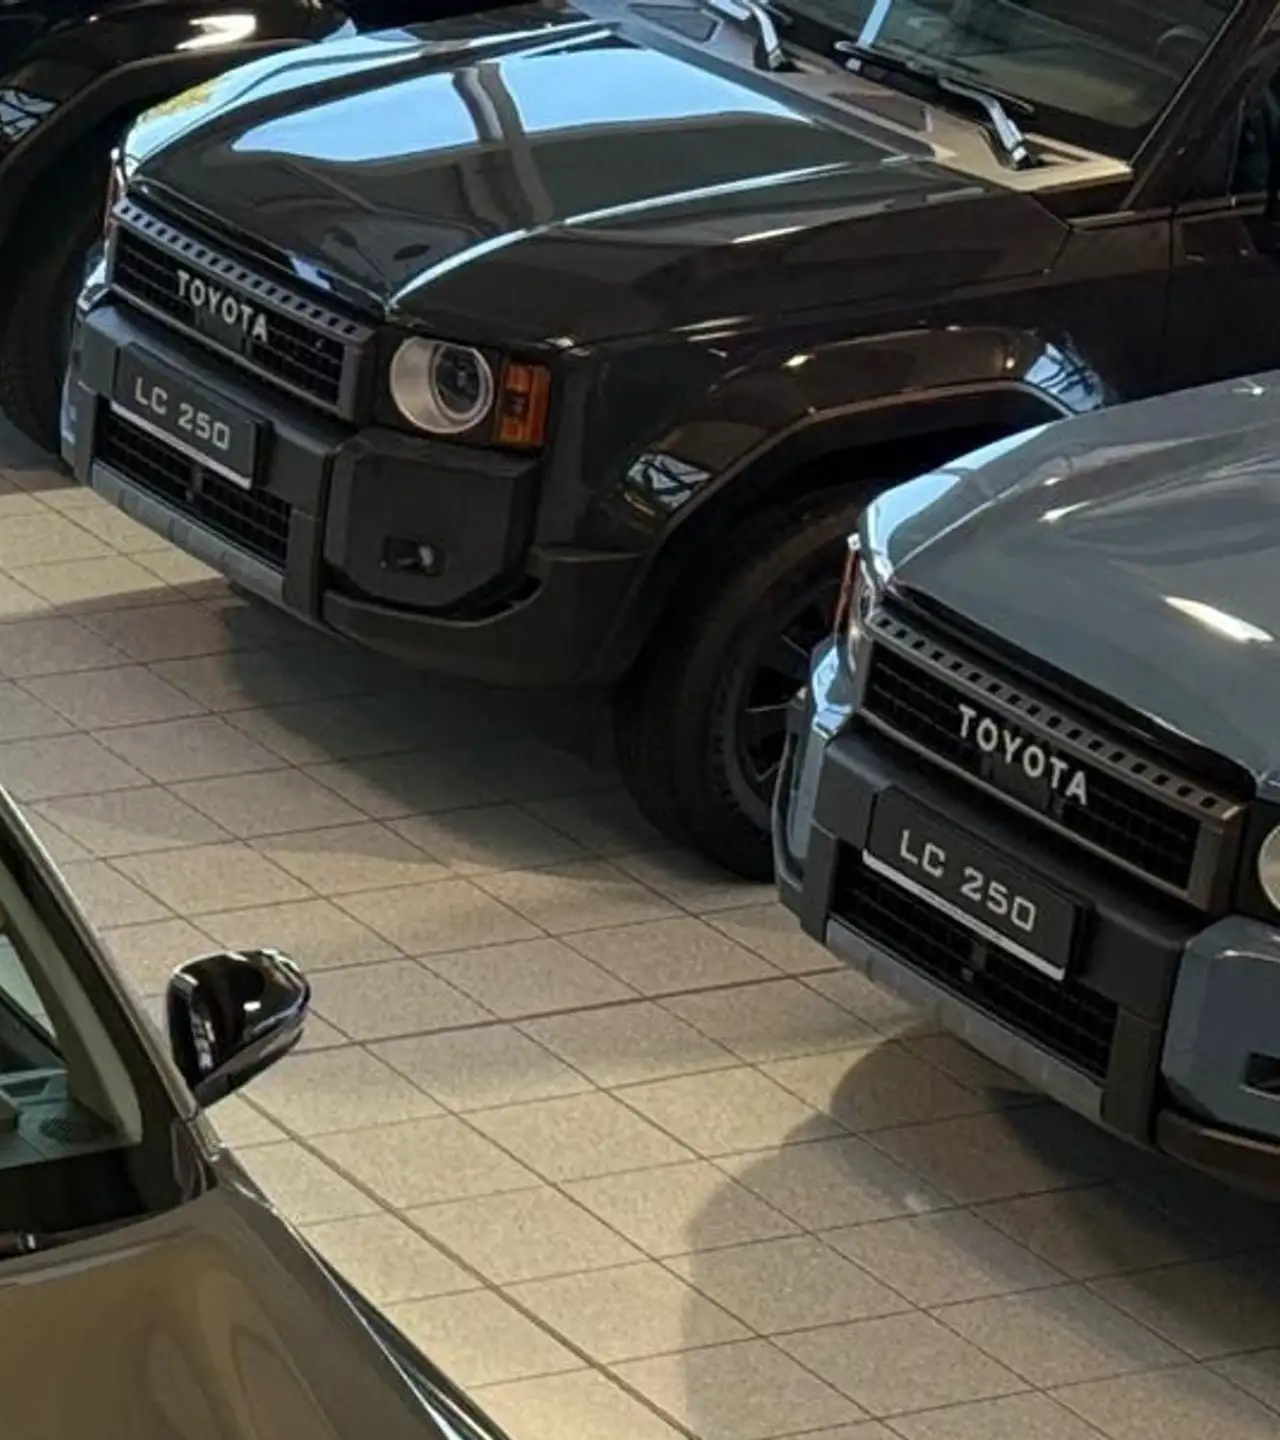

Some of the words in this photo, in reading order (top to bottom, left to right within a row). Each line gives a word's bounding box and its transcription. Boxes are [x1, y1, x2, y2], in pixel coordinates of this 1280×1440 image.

[176, 269, 268, 342] TOYOTA
[134, 377, 168, 415] LC
[177, 402, 231, 450] 250
[958, 703, 1088, 806] TOYOTA
[900, 829, 946, 878] LC
[960, 866, 1037, 932] 250
